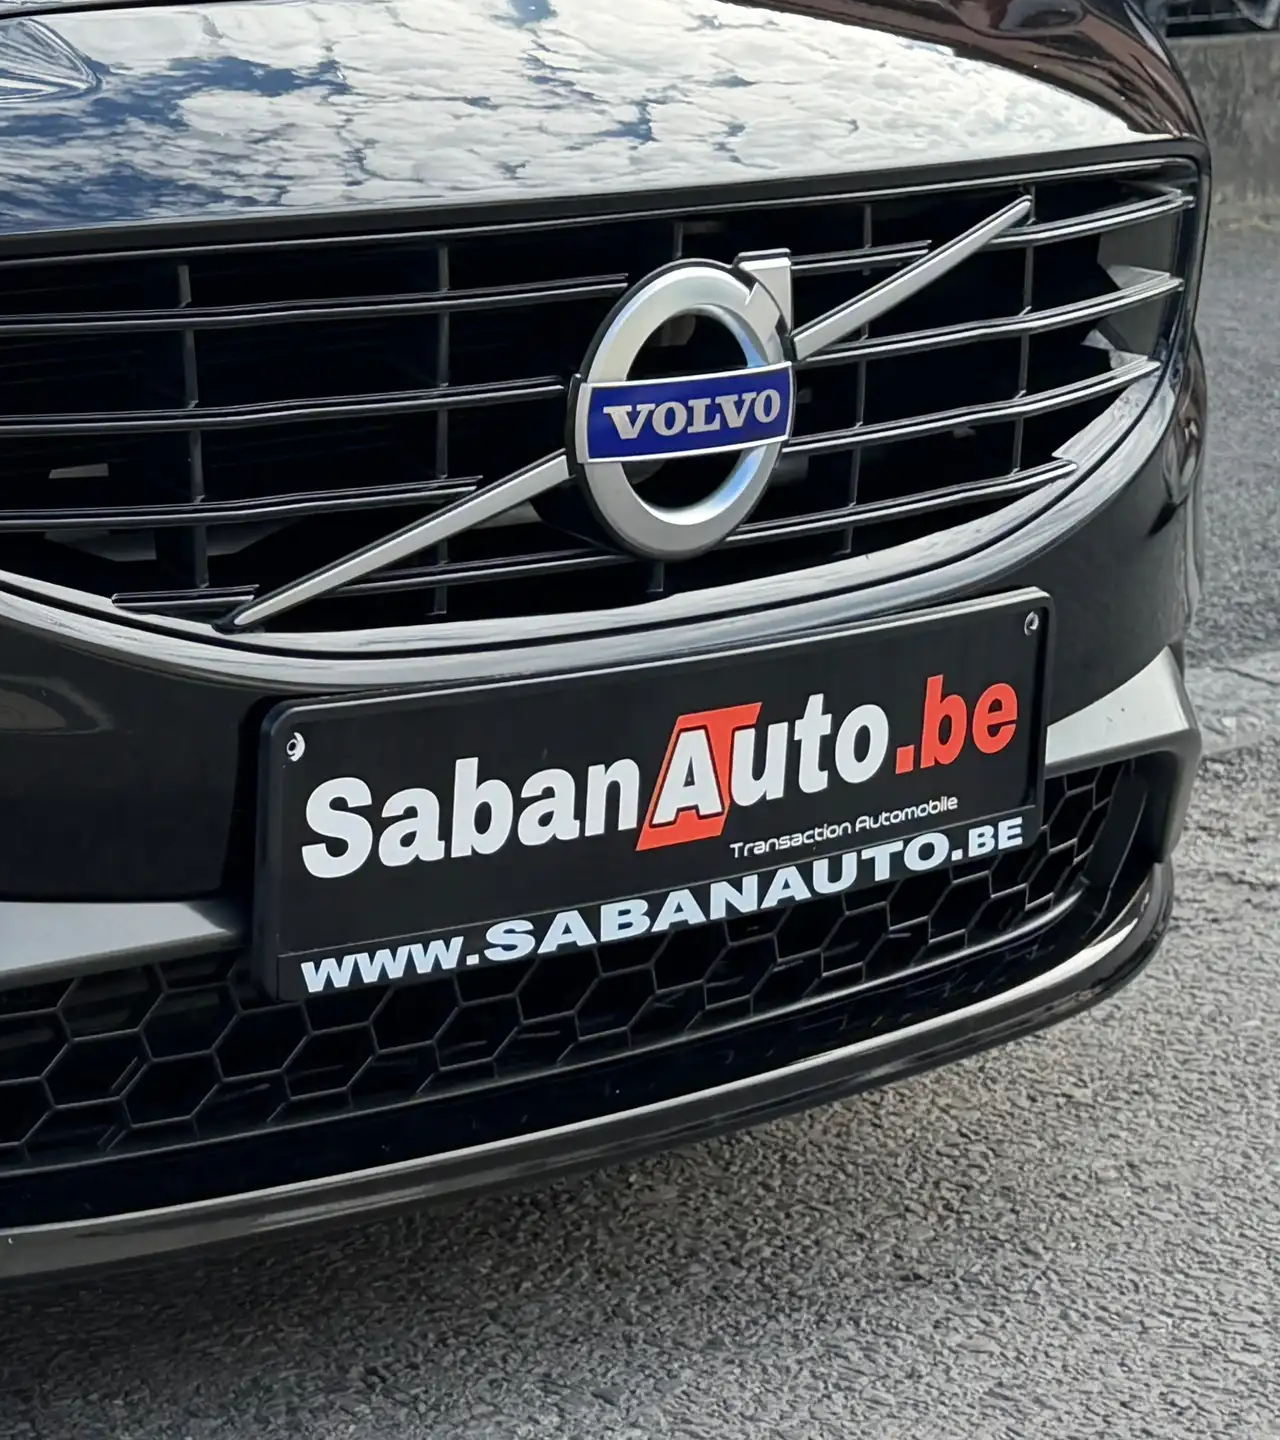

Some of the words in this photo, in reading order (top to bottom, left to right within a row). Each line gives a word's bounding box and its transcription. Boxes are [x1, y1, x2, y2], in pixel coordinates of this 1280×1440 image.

[603, 388, 781, 440] VOLVO
[299, 673, 1020, 880] SabanAuto.be
[729, 821, 852, 859] Transaction
[855, 796, 959, 833] Automobile
